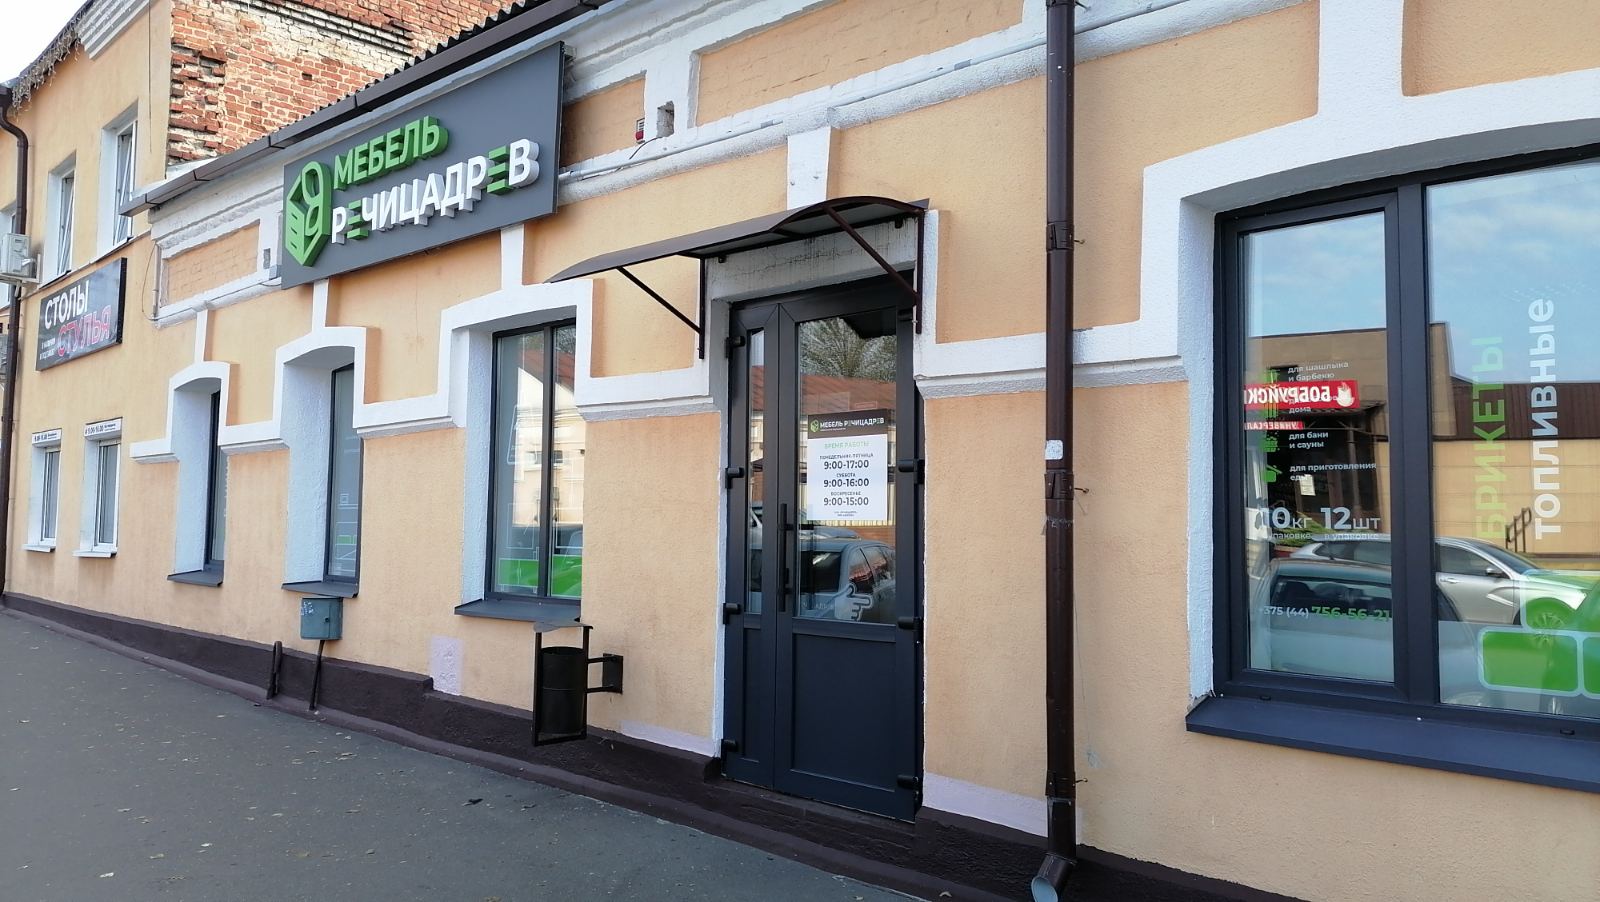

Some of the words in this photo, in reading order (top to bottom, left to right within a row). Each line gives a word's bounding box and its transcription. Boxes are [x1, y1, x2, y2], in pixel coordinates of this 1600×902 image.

[333, 115, 449, 191] МЕБЕЛЬ
[331, 138, 540, 244] РЕЧИЦАДРЕВ
[44, 280, 90, 330] СТОЛЫ
[58, 304, 113, 357] СТУЛЬЯ
[1288, 366, 1304, 374] для
[1305, 361, 1349, 371] шашлыка
[1296, 372, 1336, 382] барбекю
[820, 420, 844, 429] МЕБЕЛЬ
[844, 417, 885, 428] РЕЧИЦАДРЕВ
[1306, 431, 1329, 439] бани
[1472, 335, 1508, 539] БРИКЕТЫ
[1297, 441, 1325, 450] сауны
[824, 459, 870, 470] 9:00-17:00
[1289, 465, 1307, 473] для
[1307, 462, 1378, 473] приготовления
[823, 478, 870, 488] 9:00-16:00
[823, 496, 870, 506] 9:00-15:00
[1285, 606, 1310, 618] (44)
[1310, 606, 1390, 622] 756-56-21
